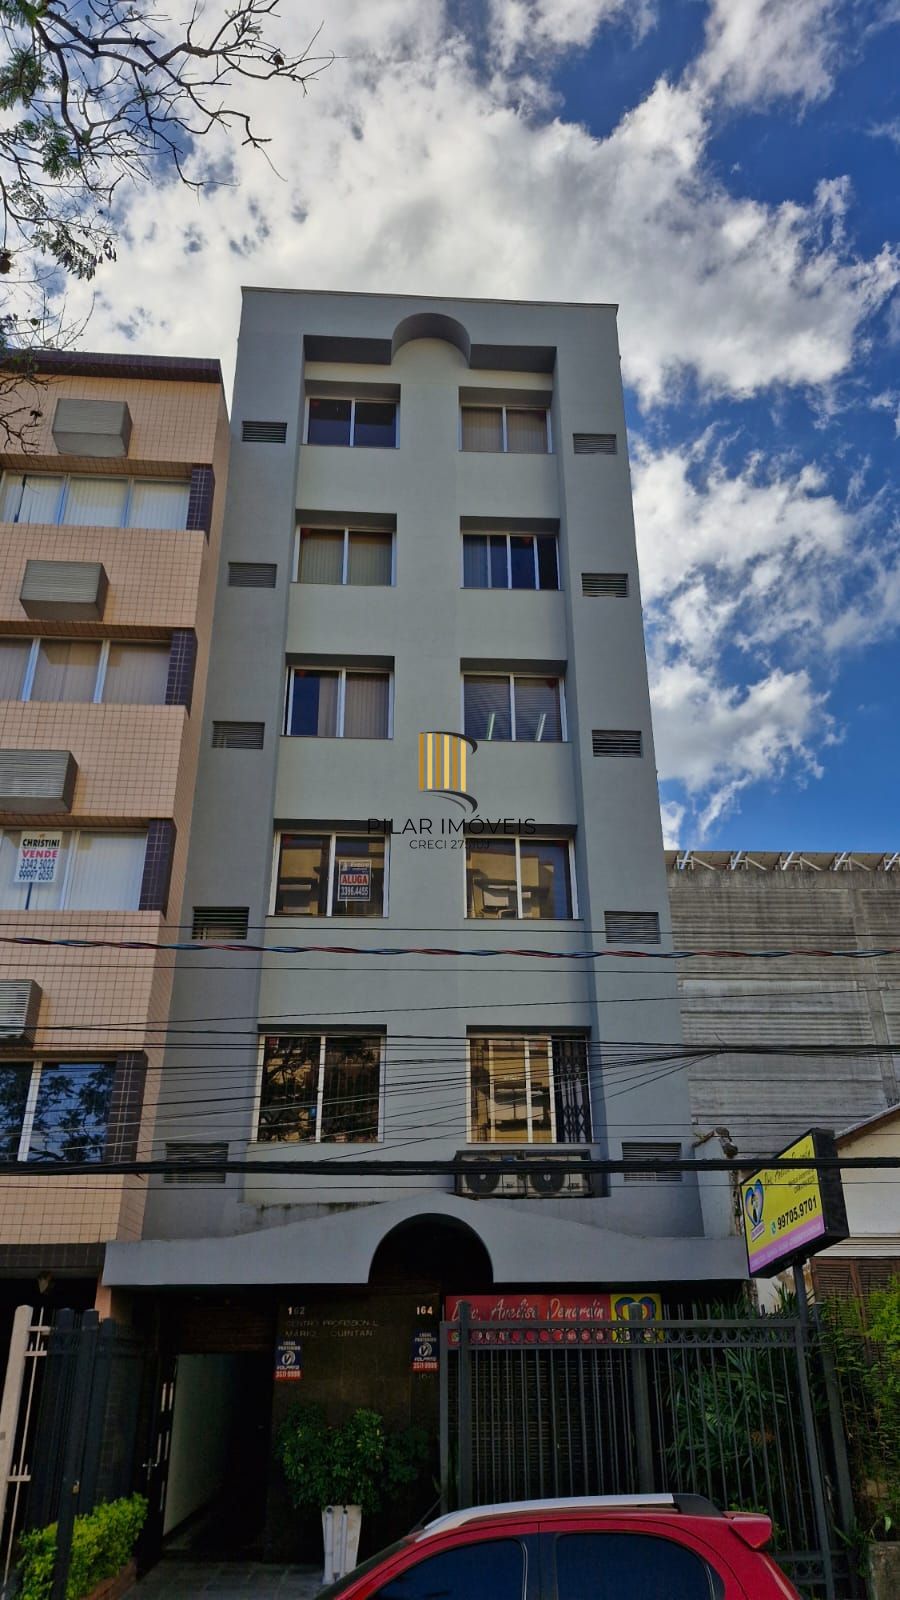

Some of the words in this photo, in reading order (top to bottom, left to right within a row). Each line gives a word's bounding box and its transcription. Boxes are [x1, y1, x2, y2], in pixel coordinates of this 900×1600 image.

[22, 839, 60, 848] CHRISTINI
[22, 850, 58, 858] VENDE
[20, 858, 38, 870] 3342
[38, 858, 56, 870] 5022
[341, 875, 369, 884] ALUGA
[777, 1196, 818, 1230] 99705.9701
[416, 1305, 433, 1315] 164
